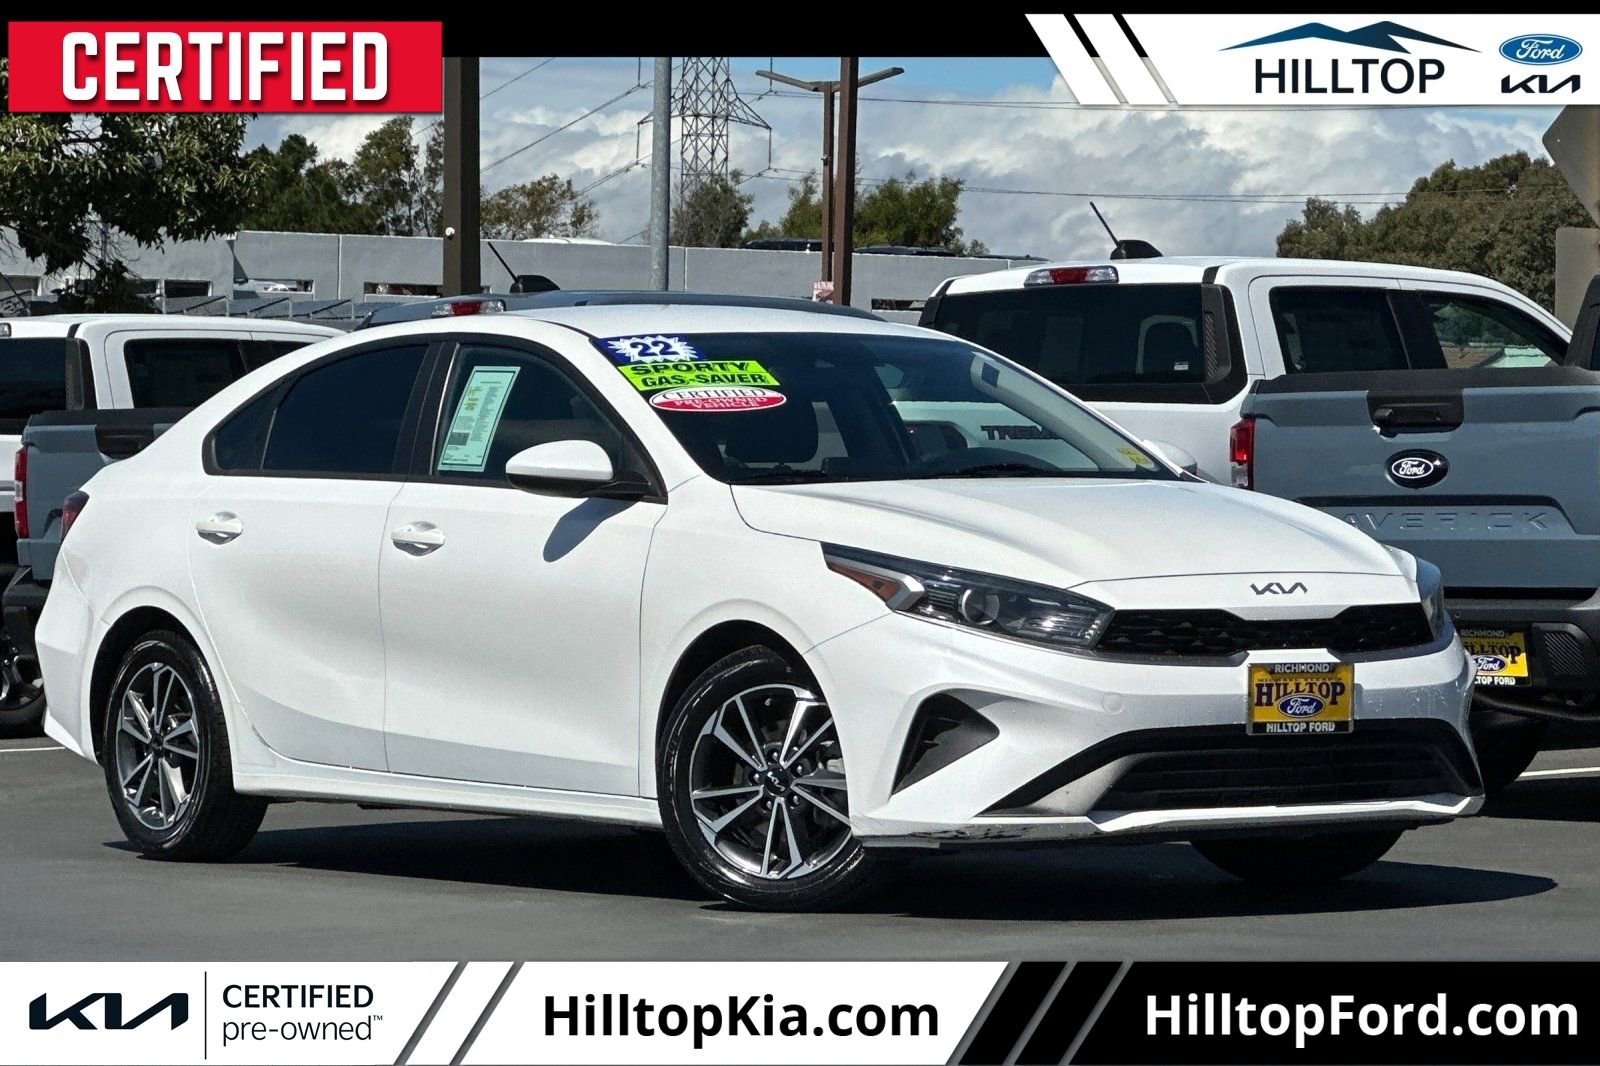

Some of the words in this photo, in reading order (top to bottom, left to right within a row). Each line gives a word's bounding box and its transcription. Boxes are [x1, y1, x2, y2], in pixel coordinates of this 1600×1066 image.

[629, 340, 680, 357] 22
[630, 361, 750, 376] SPORTY
[641, 373, 766, 388] GAS-SAVER
[662, 387, 767, 400] CERTIFIED
[693, 400, 761, 409] VEHICLE
[1399, 460, 1425, 476] Ford
[1343, 512, 1549, 531] AVERICK
[1250, 582, 1308, 595] KIA
[1460, 629, 1506, 638] RICHMOND
[1274, 663, 1330, 673] RICHMOND
[1477, 657, 1501, 671] Ford
[1494, 676, 1516, 686] FORD
[1254, 681, 1346, 707] HILLTOP
[1286, 698, 1316, 714] Ford
[1266, 722, 1307, 733] HILLTOP
[1309, 722, 1336, 732] FORD
